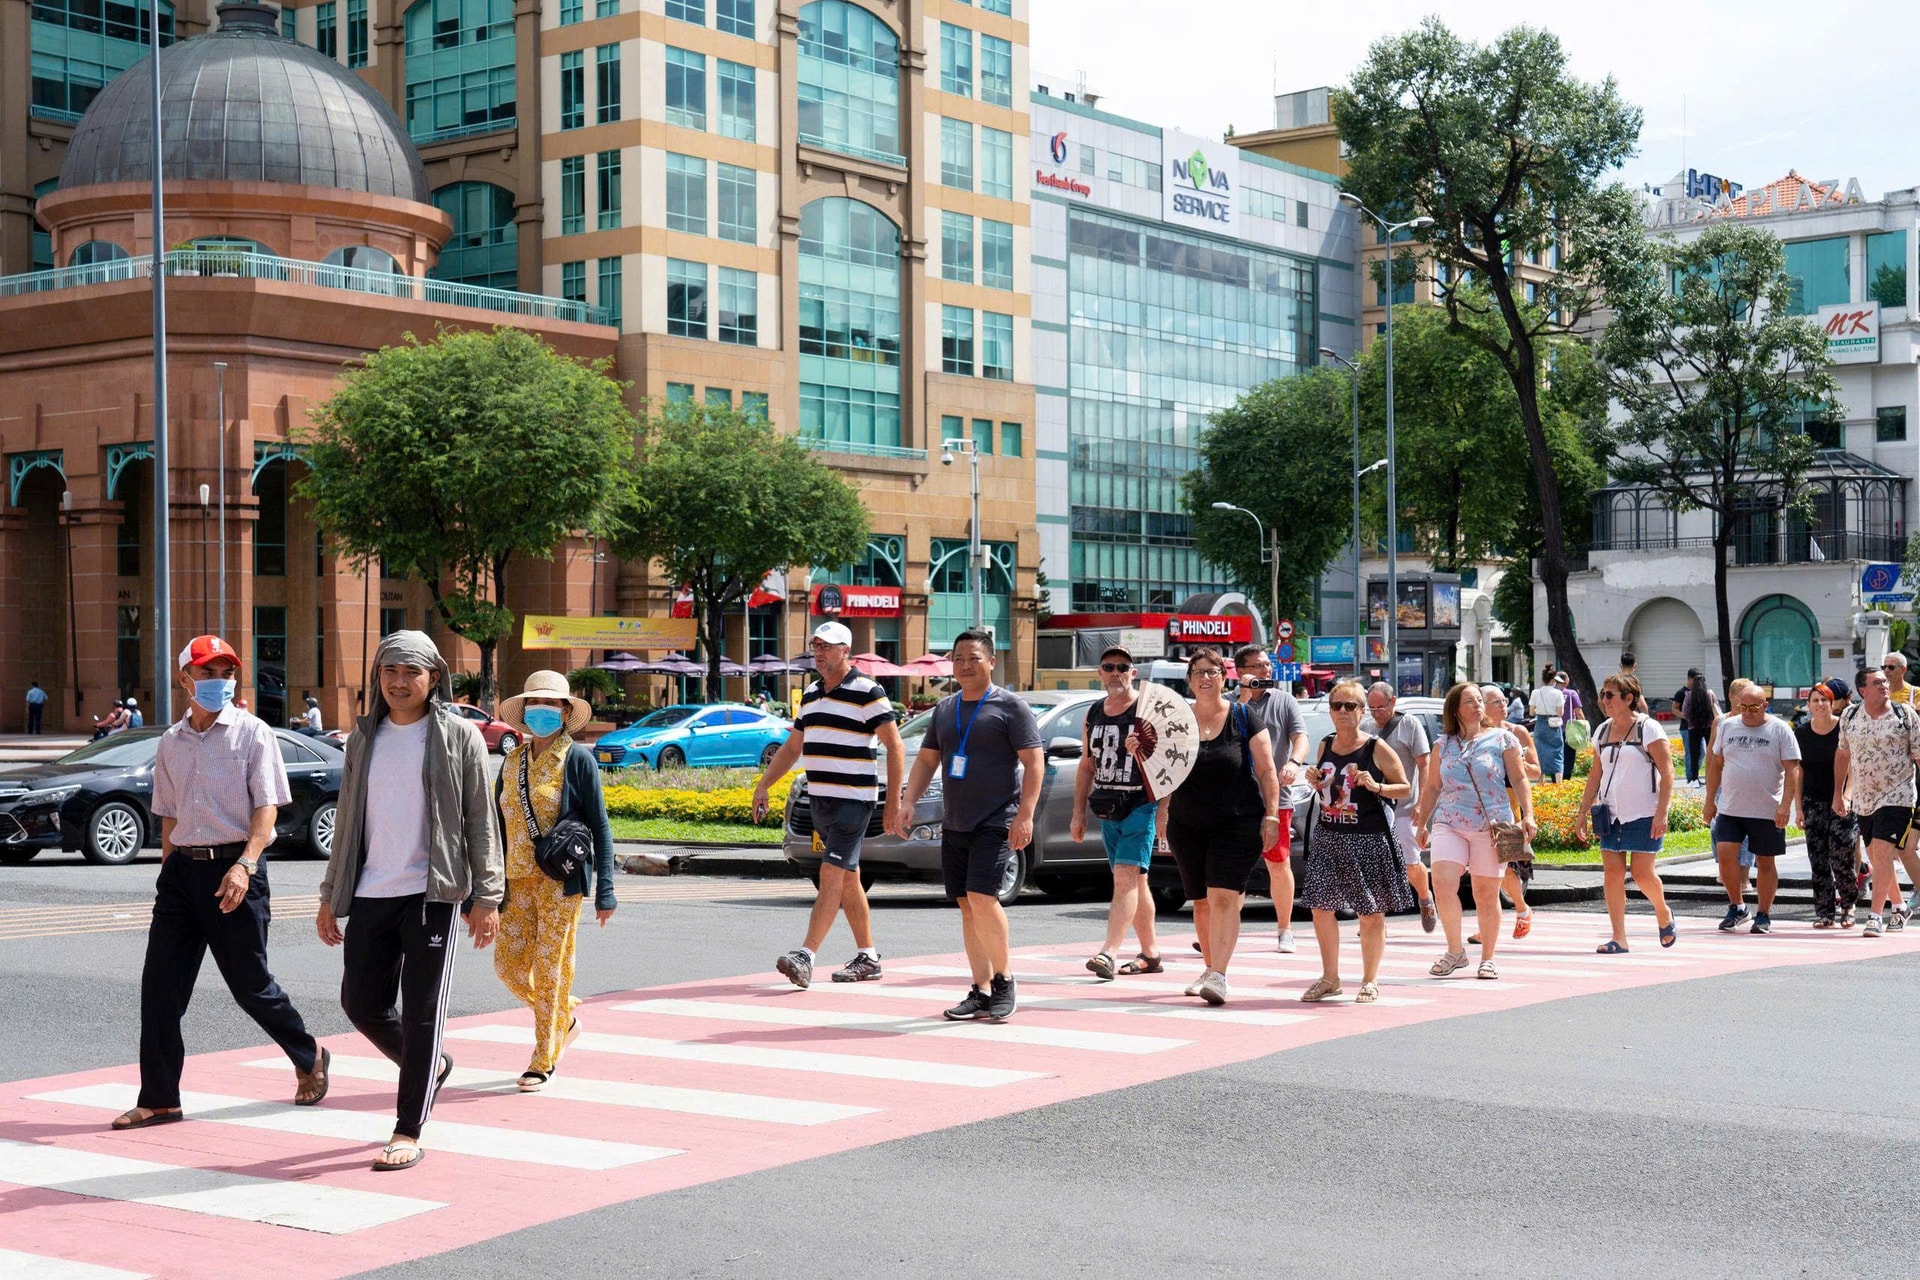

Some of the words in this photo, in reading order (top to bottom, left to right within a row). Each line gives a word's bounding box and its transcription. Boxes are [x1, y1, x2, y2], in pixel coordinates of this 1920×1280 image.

[1173, 150, 1230, 191] NOVA
[1746, 176, 1868, 217] PLAZA
[1173, 193, 1230, 223] SERVICE
[1825, 309, 1873, 336] MK
[1827, 337, 1876, 347] ESTAURANTS
[846, 594, 900, 609] PHINDELI
[1182, 620, 1231, 636] PHINDELI
[1320, 810, 1359, 824] ESTIES
